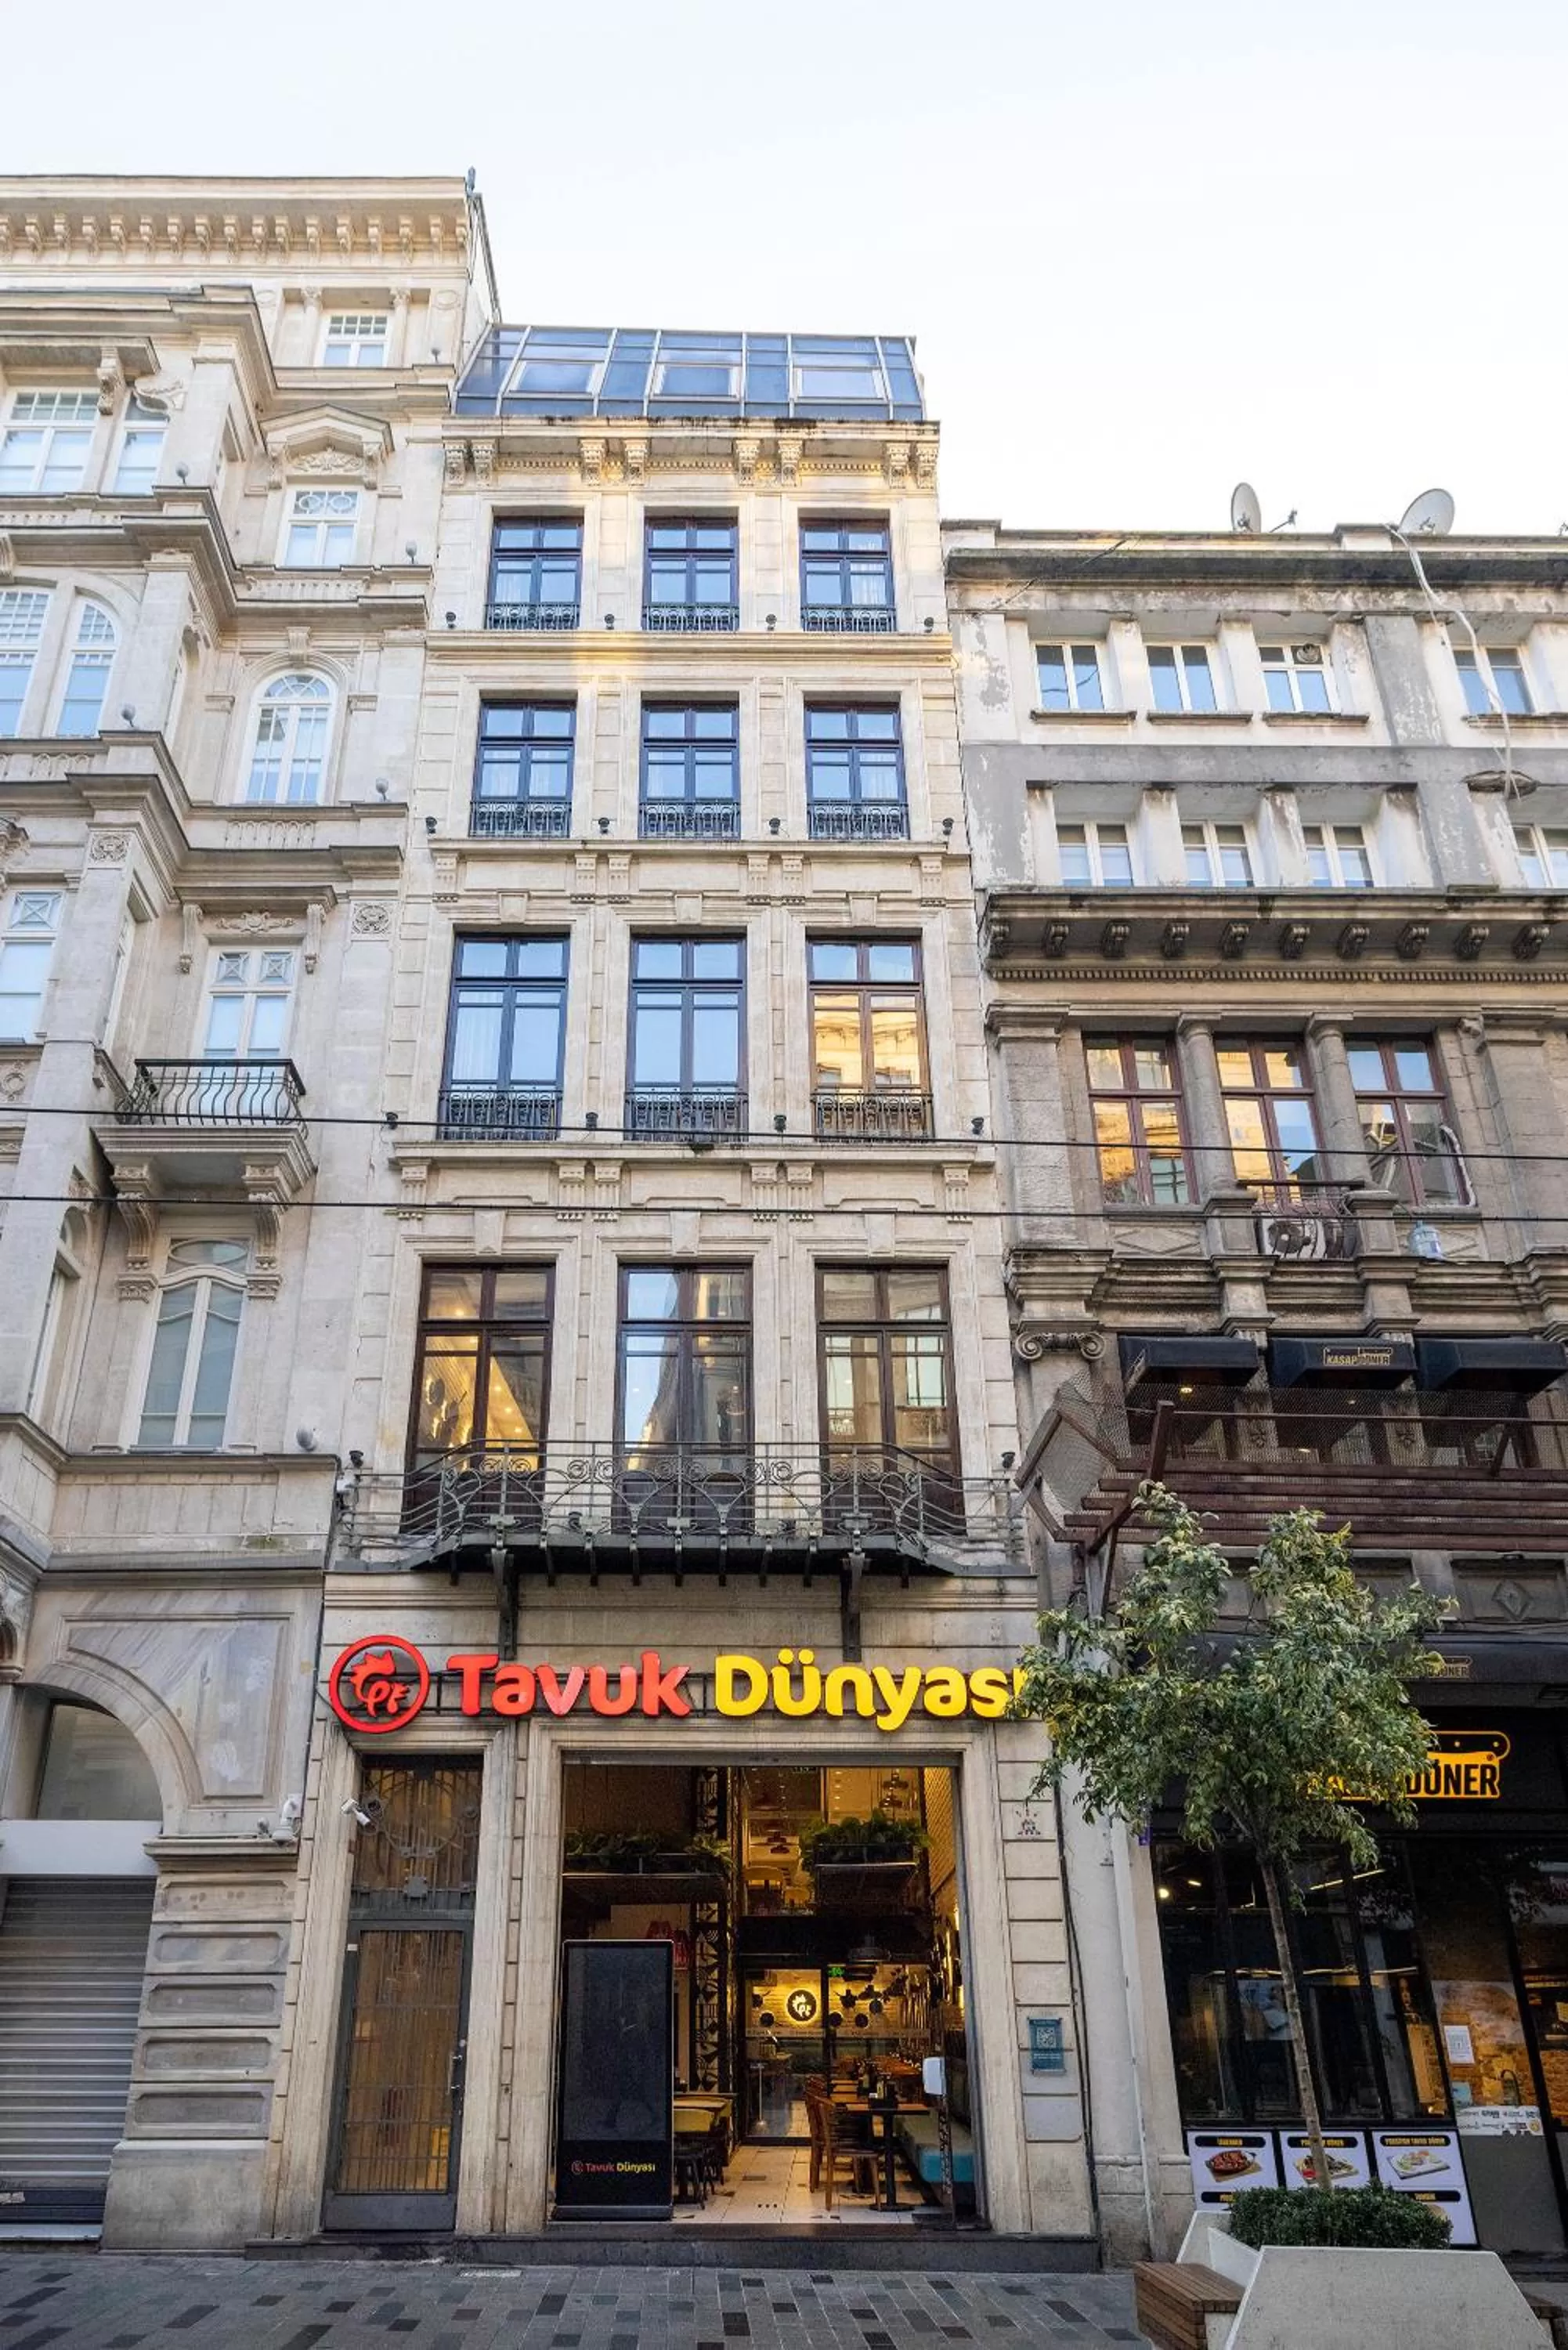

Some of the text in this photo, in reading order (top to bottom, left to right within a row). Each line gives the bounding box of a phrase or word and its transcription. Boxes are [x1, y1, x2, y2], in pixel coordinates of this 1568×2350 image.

[446, 1650, 692, 1717] Tavuk
[585, 2162, 656, 2174] Tavuk Dünyası
